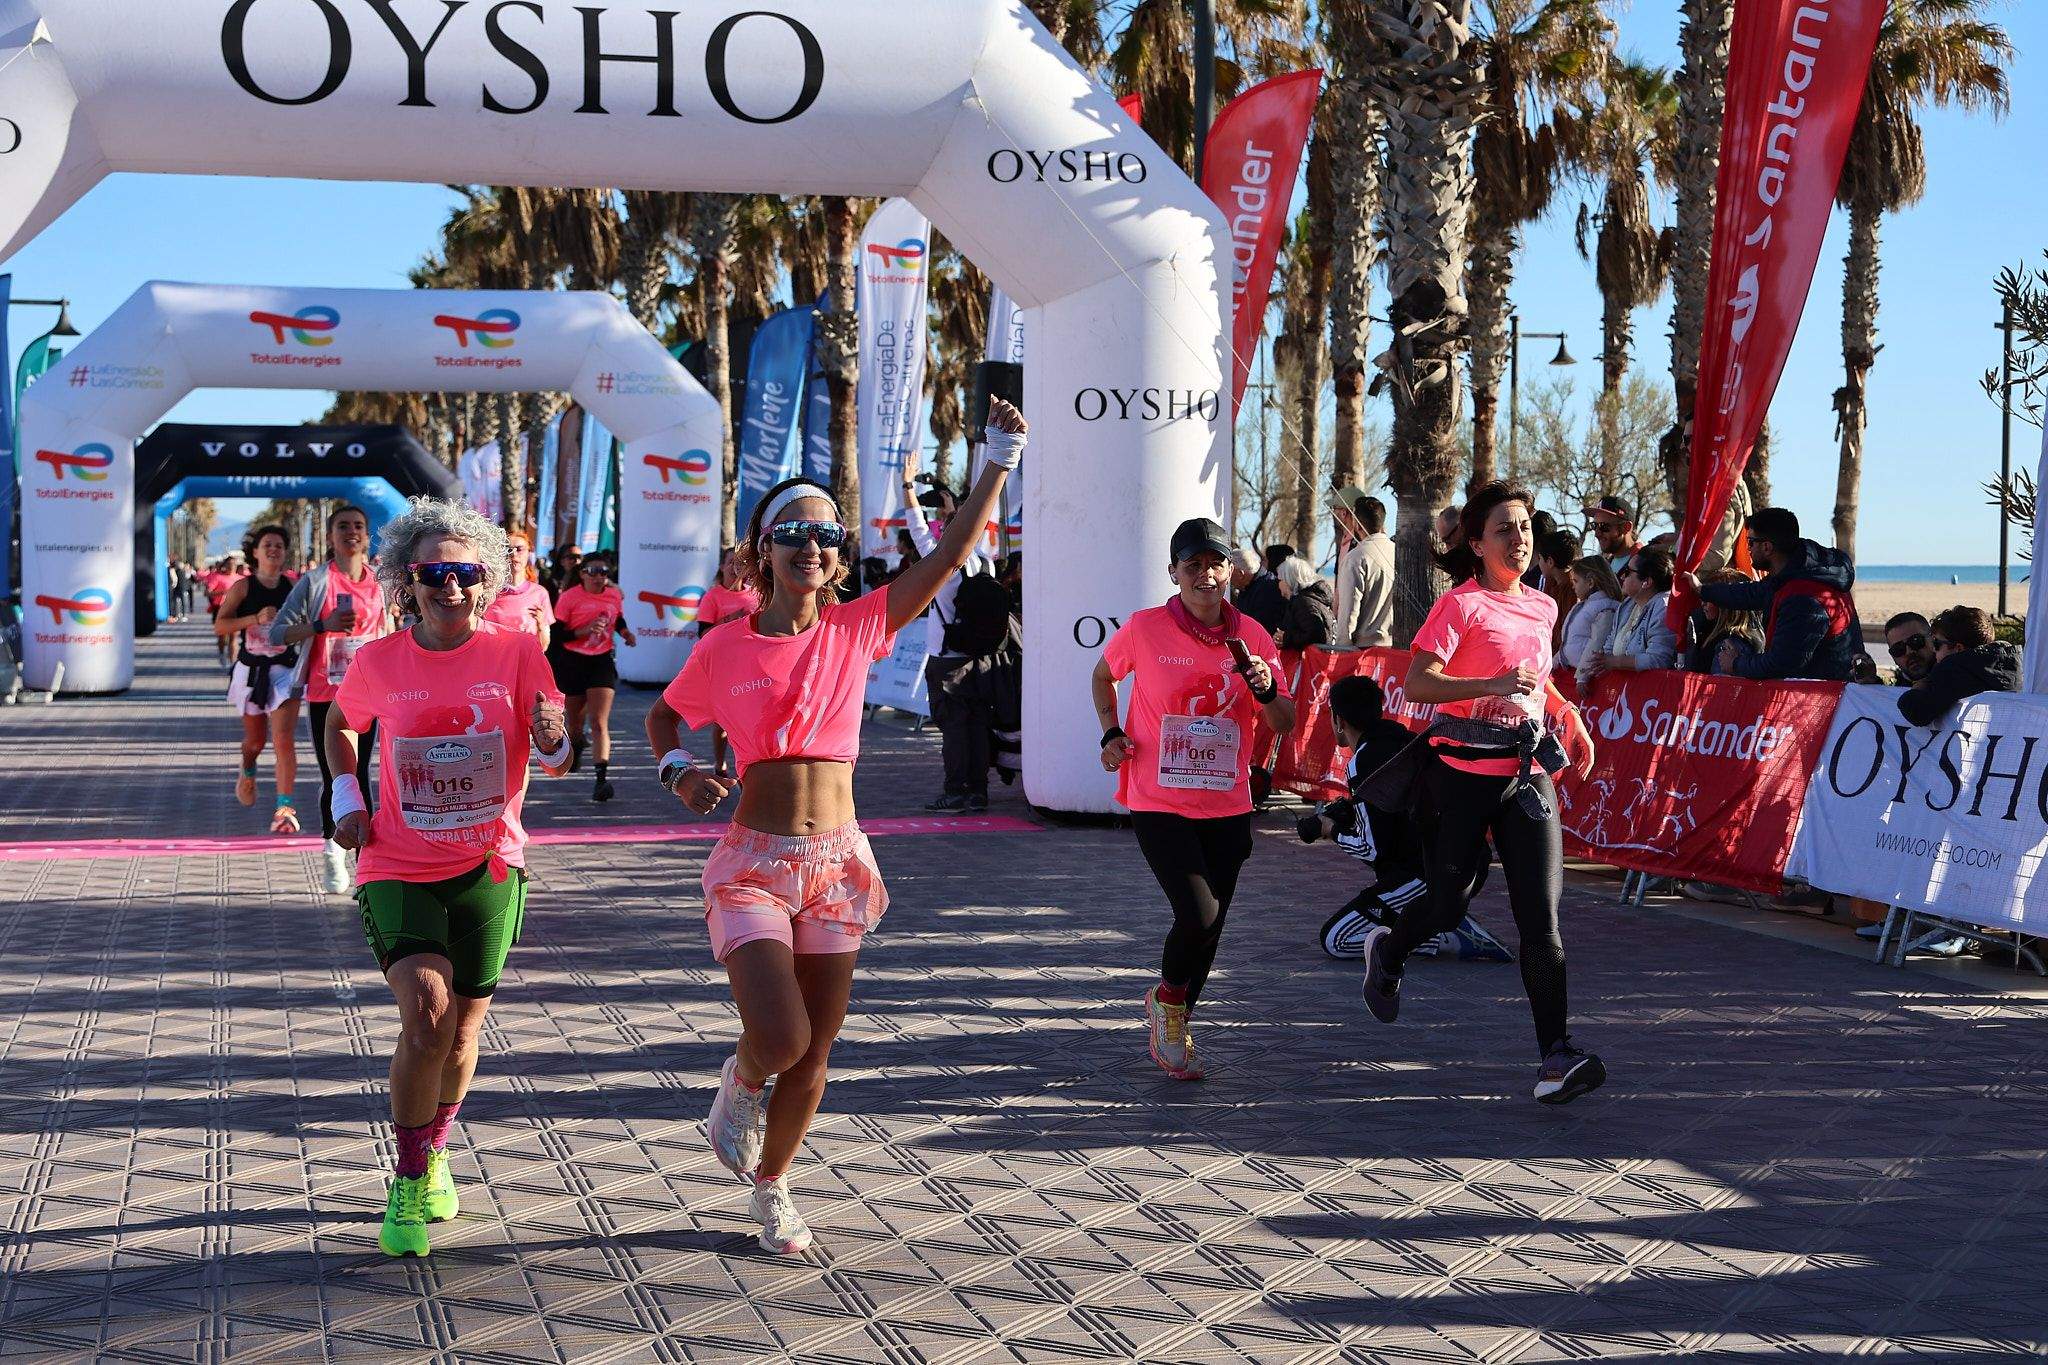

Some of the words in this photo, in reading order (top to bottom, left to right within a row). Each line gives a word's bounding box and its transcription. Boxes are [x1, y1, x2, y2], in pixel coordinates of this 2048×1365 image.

[221, 0, 825, 125] OYSHO
[1745, 0, 1831, 250] antan
[987, 149, 1148, 185] OYSHO
[1232, 140, 1273, 320] ander
[250, 353, 342, 368] TotalEnergies
[434, 356, 522, 370] TotalEnergies
[1074, 388, 1219, 422] OYSHO
[742, 381, 790, 492] Marlene
[201, 442, 367, 458] VOLVO
[1158, 655, 1194, 666] OYSHO
[731, 677, 772, 697] OYSHO
[387, 690, 429, 703] OYSHO
[1634, 698, 1794, 761] Santander
[429, 750, 470, 760] ASTURIANA
[1188, 748, 1216, 761] 016
[433, 776, 474, 794] 016
[411, 815, 444, 825] OYSHO
[465, 810, 496, 823] Santander
